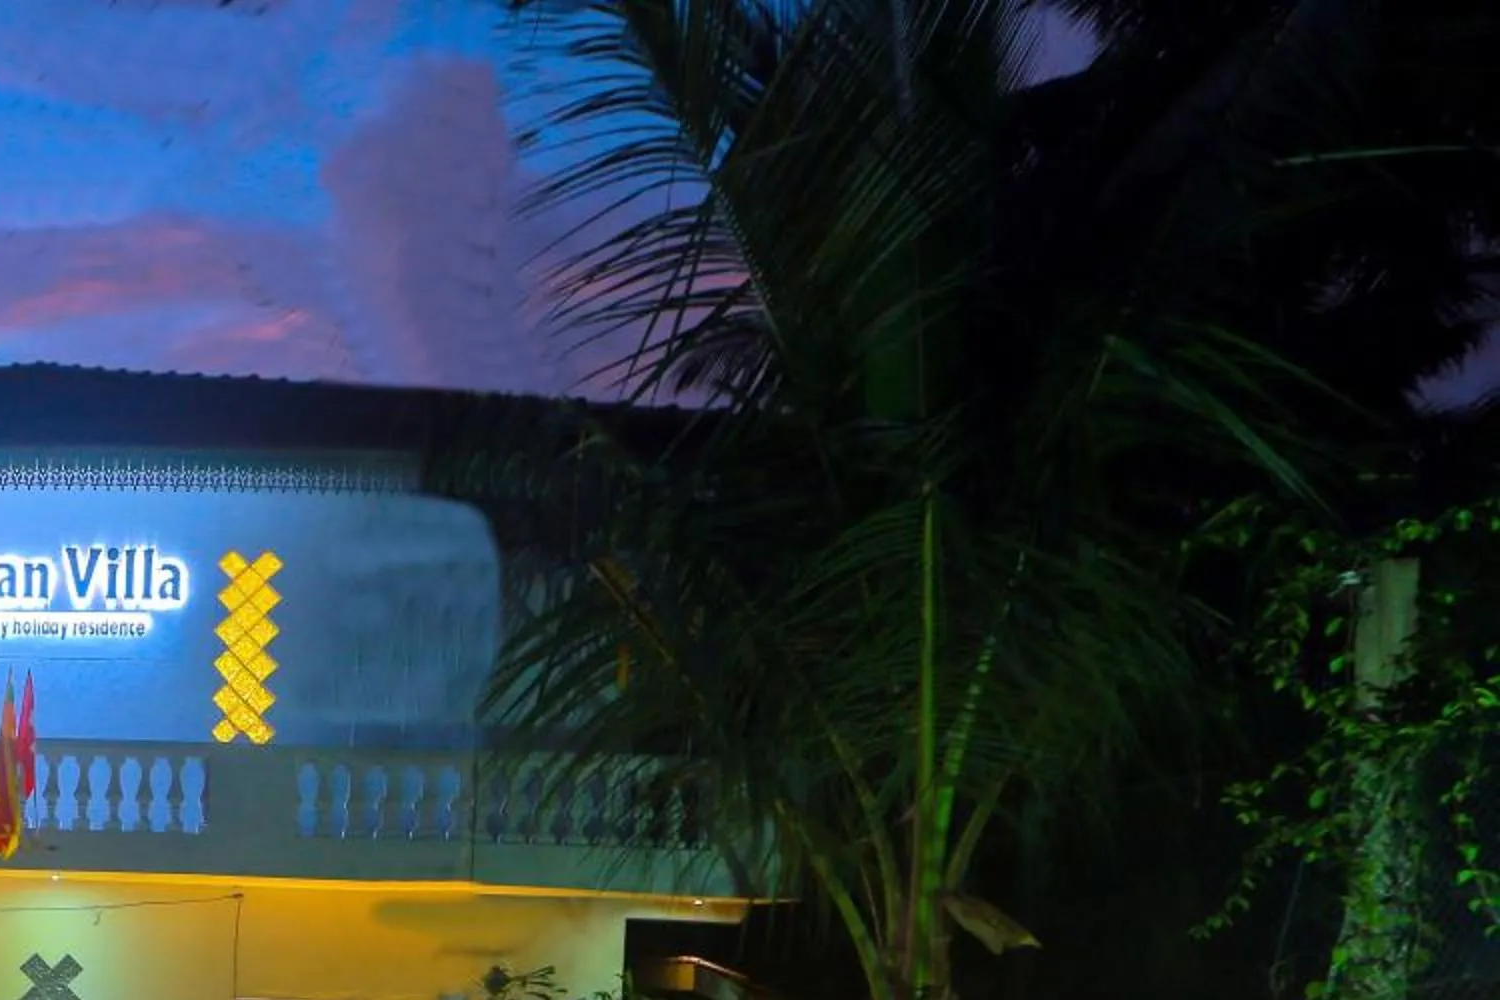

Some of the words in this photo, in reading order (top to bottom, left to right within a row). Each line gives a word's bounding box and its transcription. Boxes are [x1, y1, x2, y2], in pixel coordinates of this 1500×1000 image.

[65, 547, 182, 601] Villa
[13, 617, 68, 640] holiday
[73, 618, 145, 636] residence
